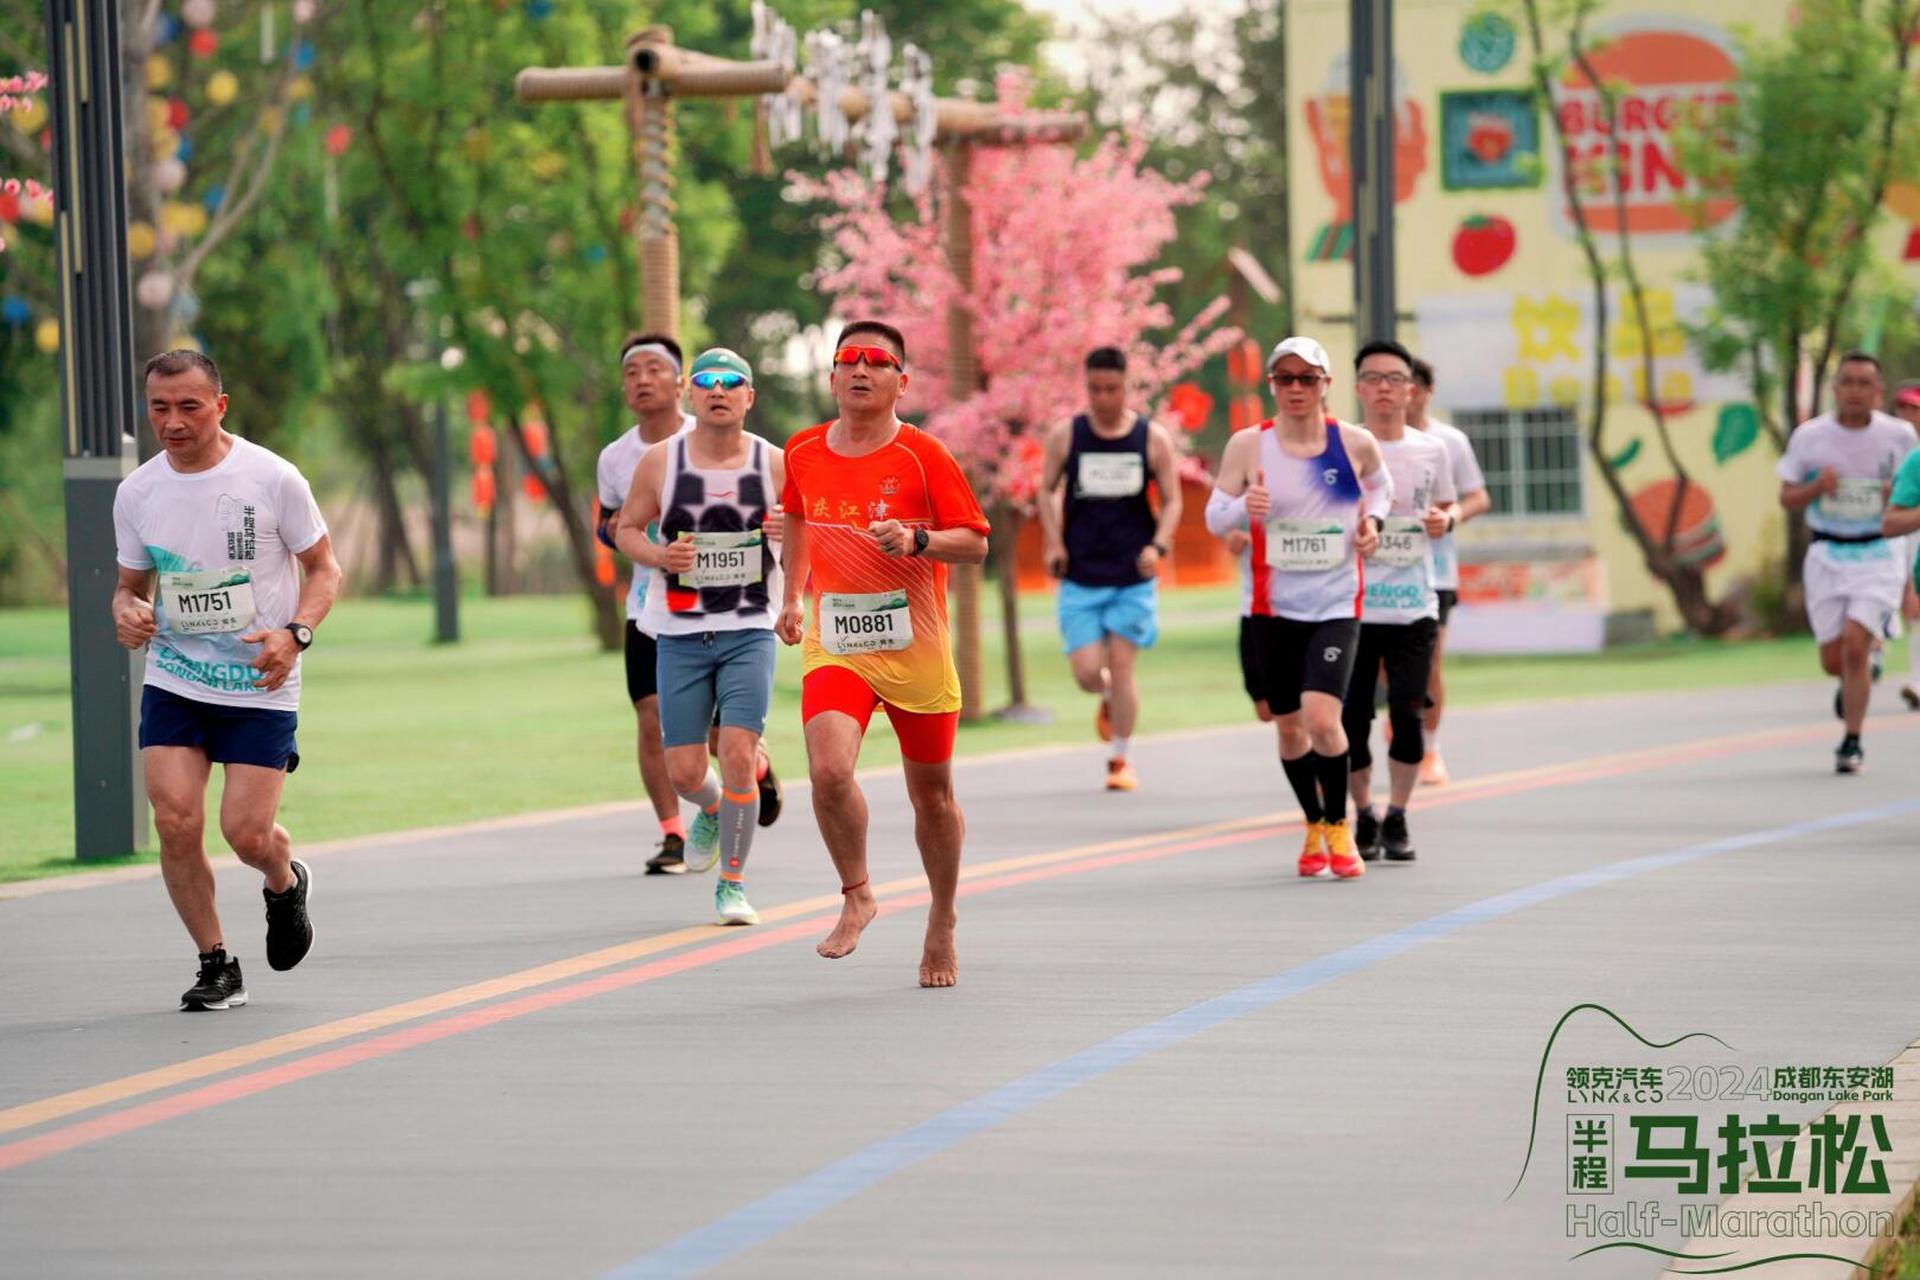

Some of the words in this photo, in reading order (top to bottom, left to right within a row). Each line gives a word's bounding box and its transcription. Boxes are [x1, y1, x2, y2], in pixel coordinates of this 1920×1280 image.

[1282, 537, 1328, 553] M1761
[697, 551, 745, 569] M1951
[178, 591, 232, 613] M1751
[834, 613, 894, 634] M0881
